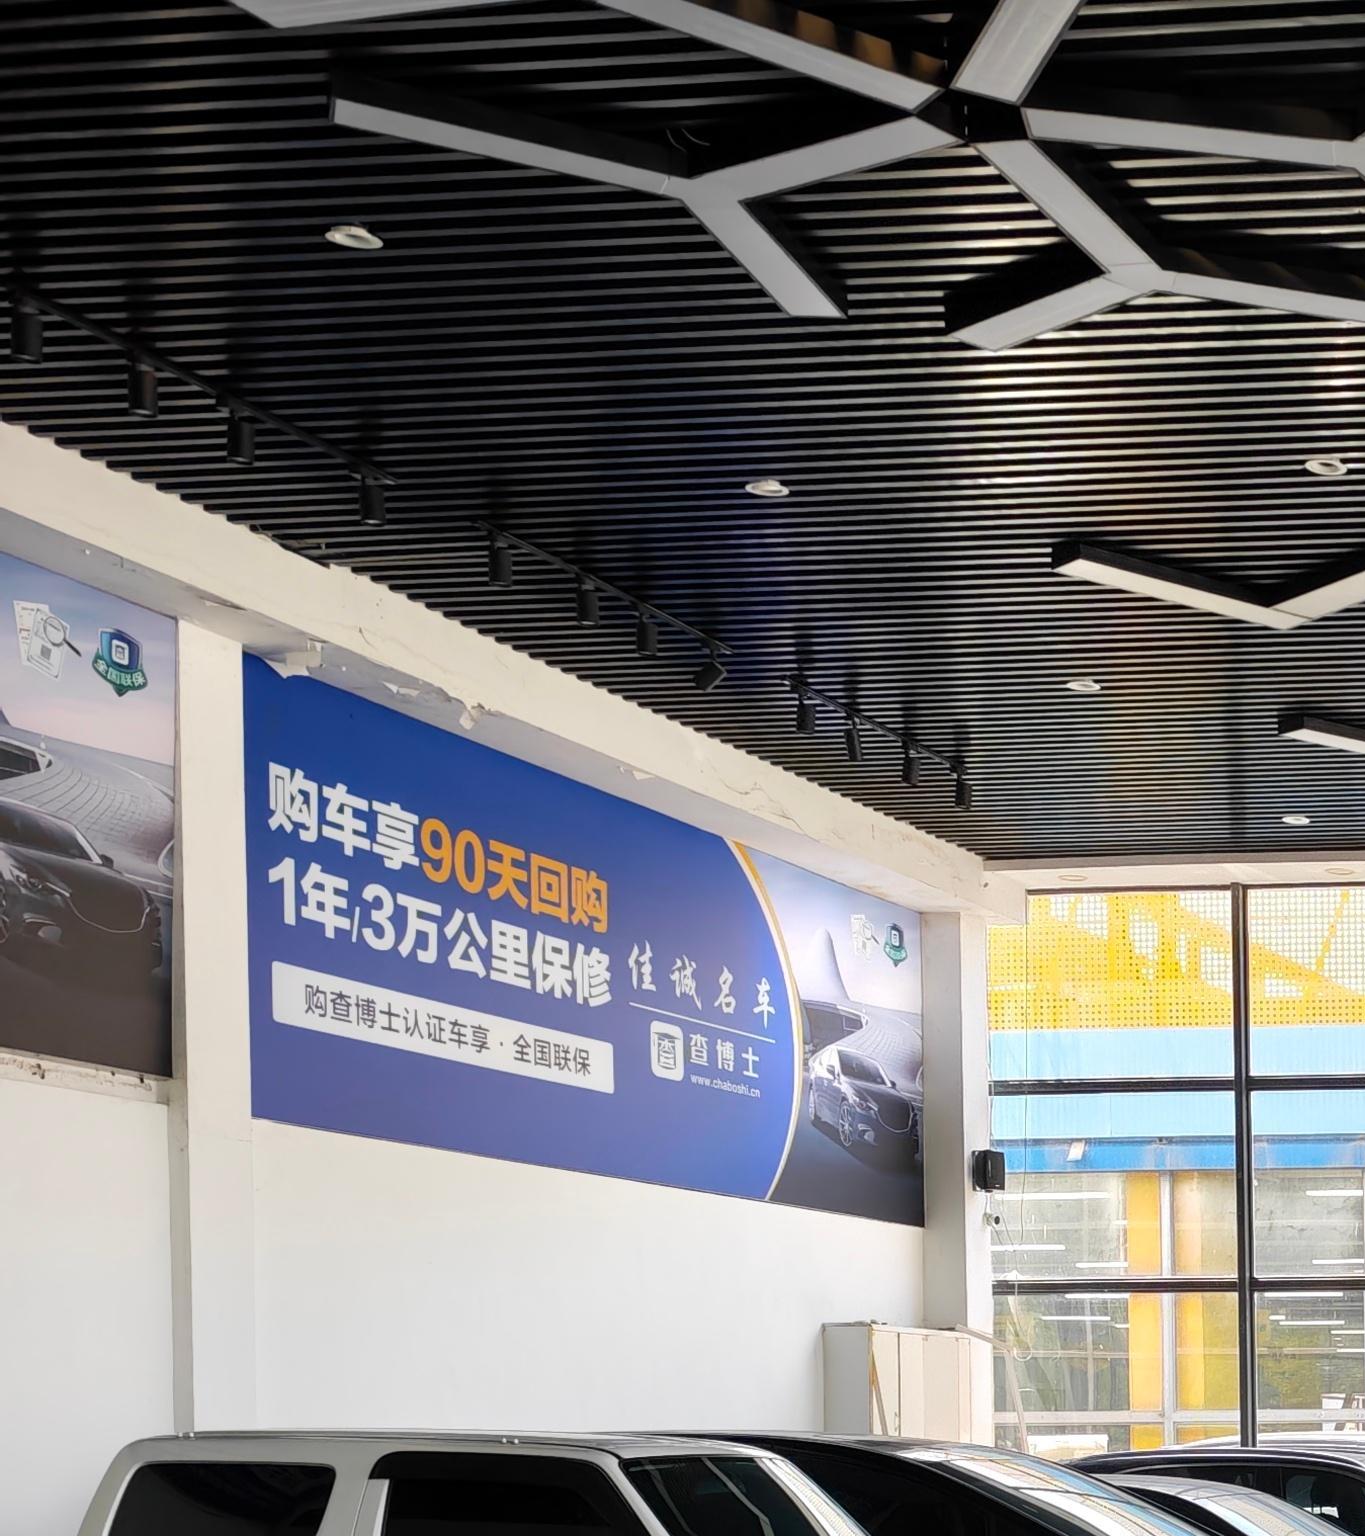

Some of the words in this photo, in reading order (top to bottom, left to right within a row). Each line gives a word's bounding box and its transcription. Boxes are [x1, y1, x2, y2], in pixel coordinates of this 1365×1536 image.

[94, 658, 146, 687] 全国联保
[267, 761, 608, 933] 购车享90天回购
[268, 857, 612, 1008] 1年/3万公里保修
[628, 939, 776, 1029] 佳诚名车
[689, 1033, 760, 1078] 查博士
[690, 1073, 761, 1098] www.chaboshi.cn
